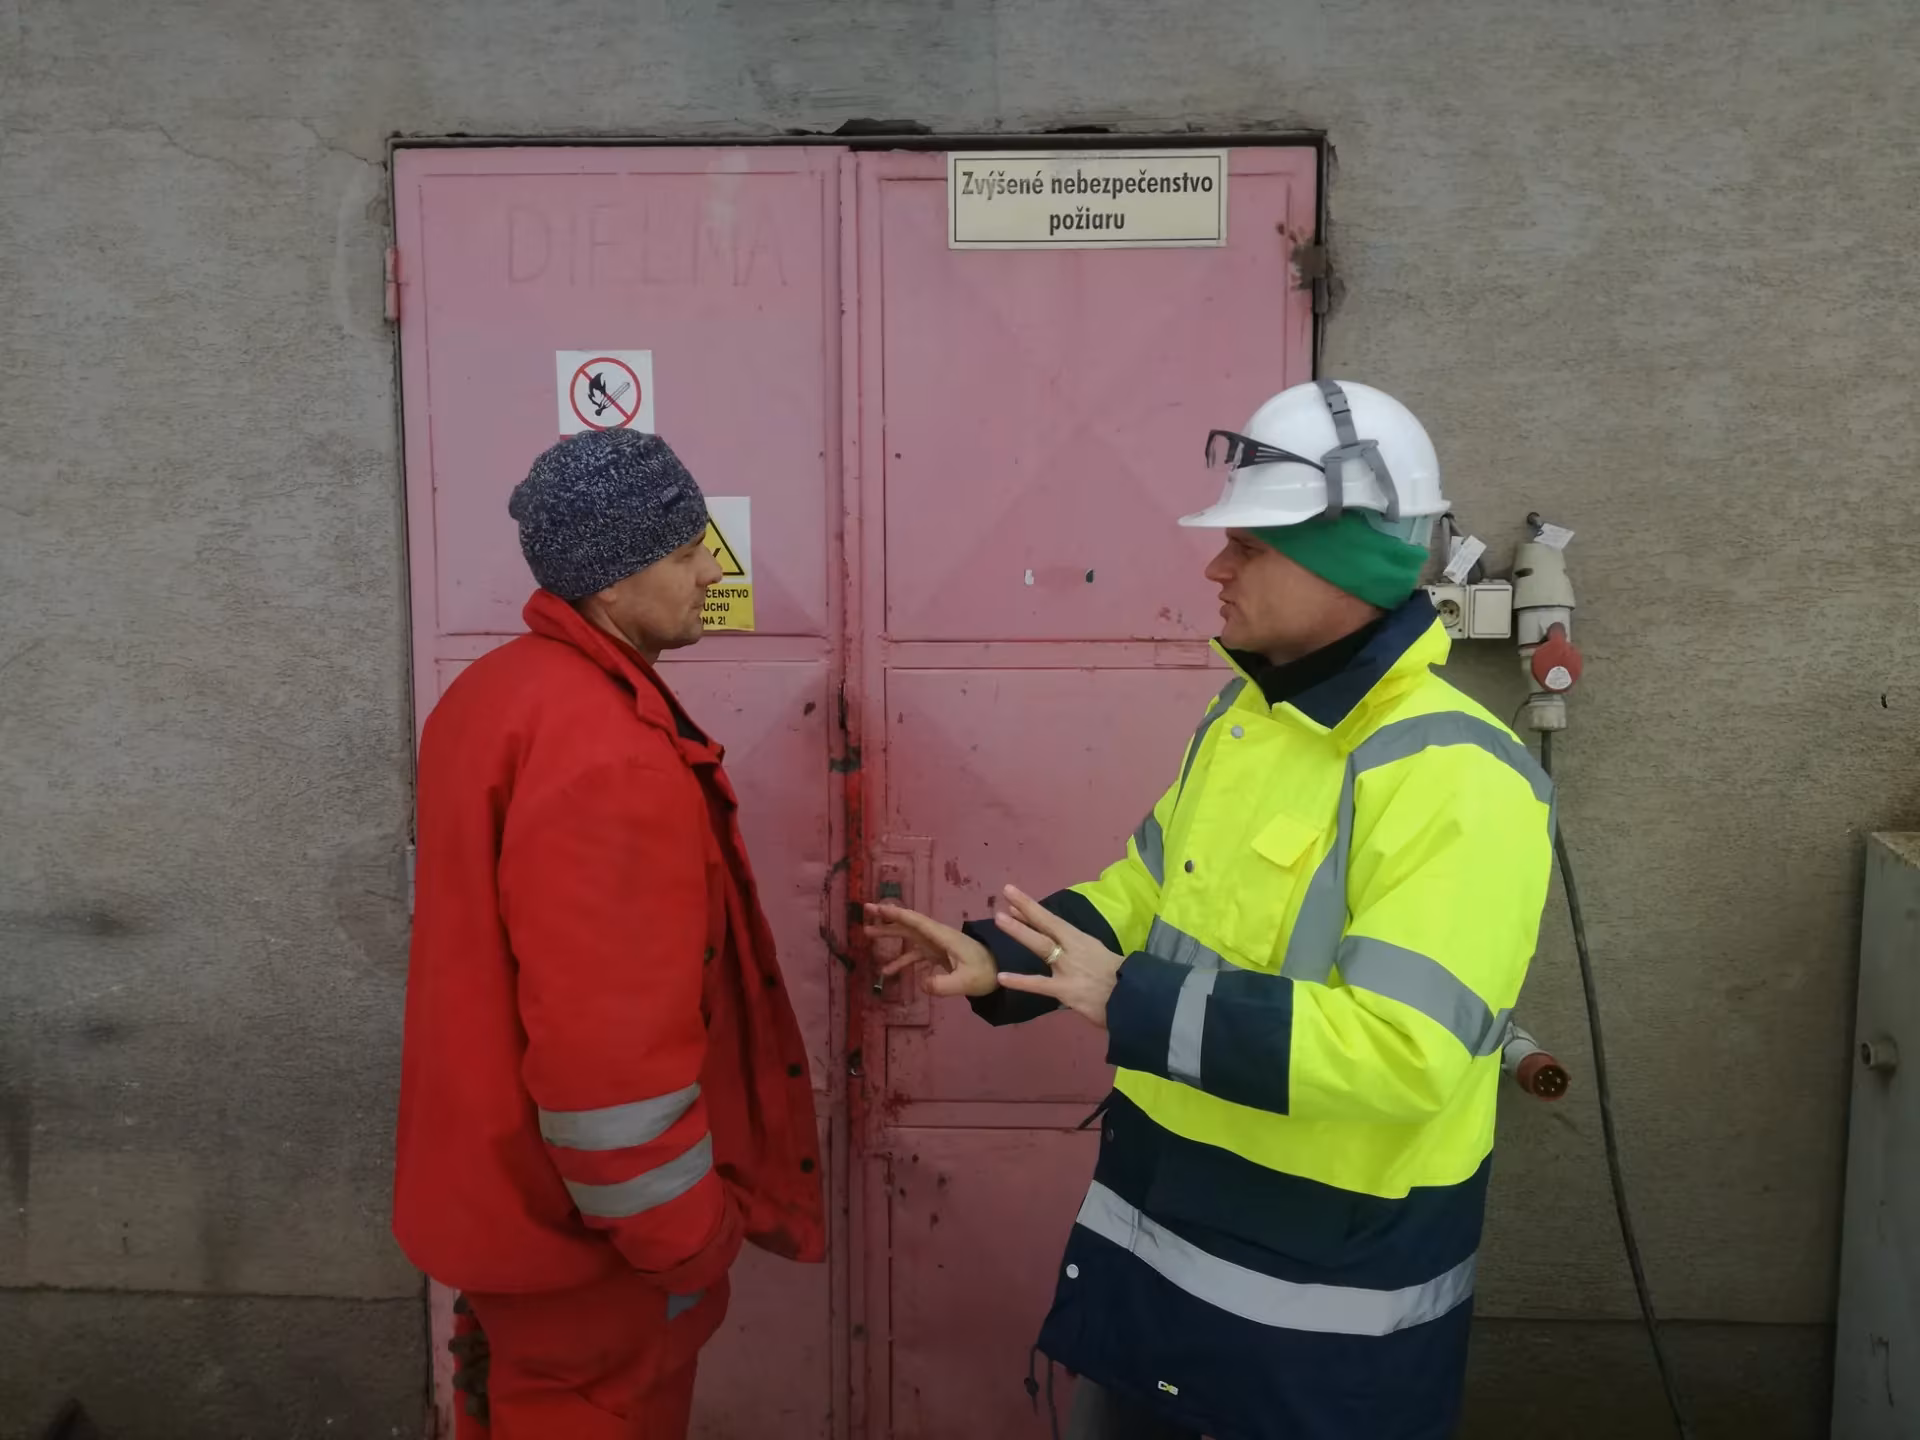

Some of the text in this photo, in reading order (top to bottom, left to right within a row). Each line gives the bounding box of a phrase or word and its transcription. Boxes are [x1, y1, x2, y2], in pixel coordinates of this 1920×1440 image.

[962, 169, 1213, 200] Zvýšené nebezpečenstvo
[1050, 205, 1125, 235] požiaru
[699, 616, 726, 625] NA 2!
